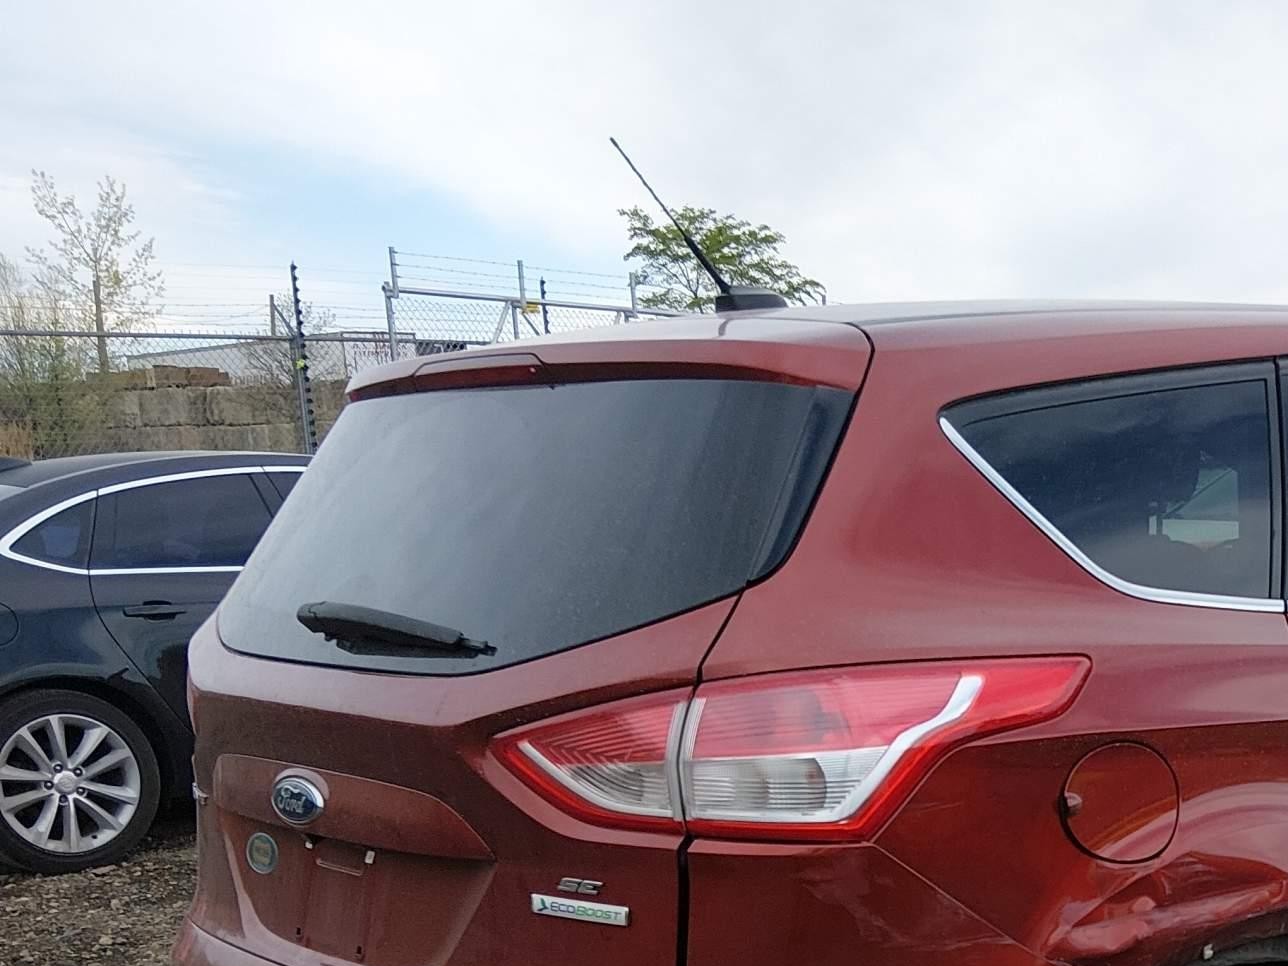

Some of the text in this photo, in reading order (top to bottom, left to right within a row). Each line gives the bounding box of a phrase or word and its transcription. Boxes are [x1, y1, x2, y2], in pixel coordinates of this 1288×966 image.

[278, 785, 307, 814] Ford
[557, 877, 604, 895] SE
[550, 901, 622, 921] ECOBOOST
